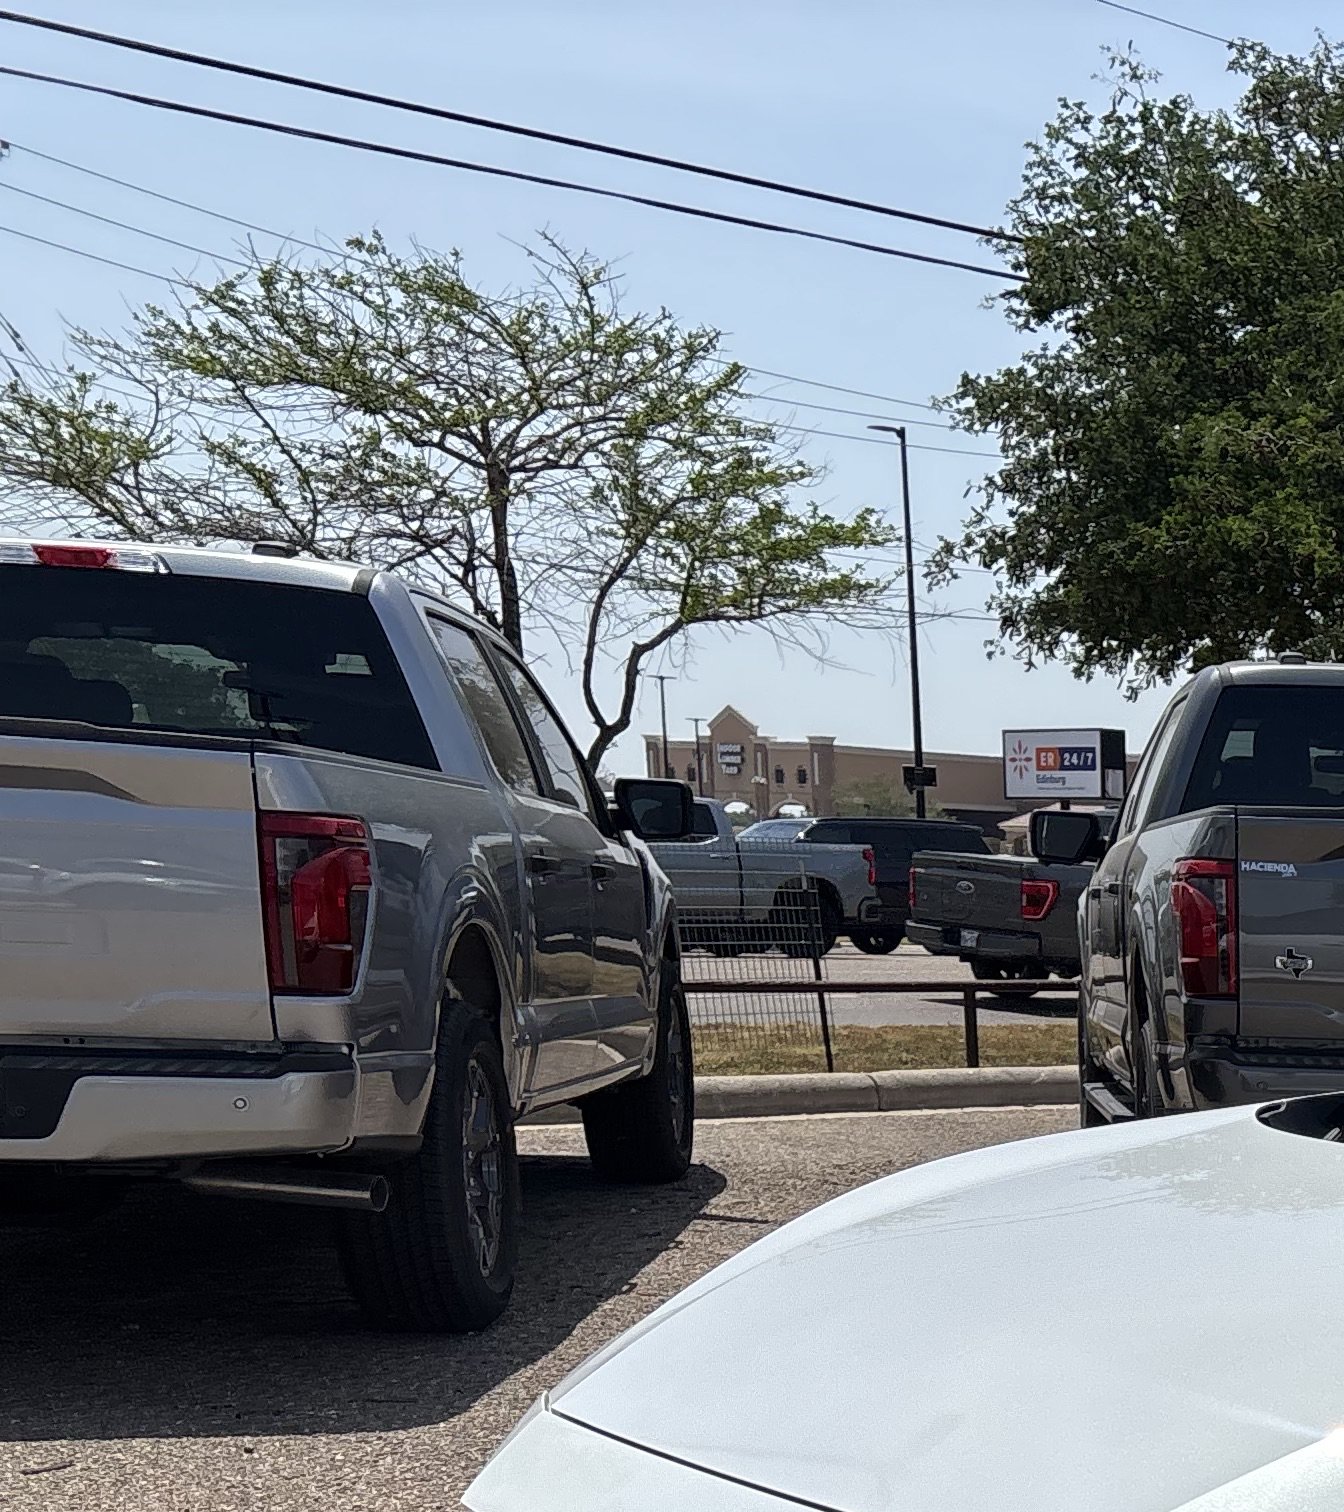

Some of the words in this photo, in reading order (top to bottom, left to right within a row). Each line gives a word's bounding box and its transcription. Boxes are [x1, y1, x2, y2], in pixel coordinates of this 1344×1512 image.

[1039, 751, 1055, 766] ER
[1063, 751, 1094, 767] 24/7
[1240, 860, 1297, 873] HACIENDA
